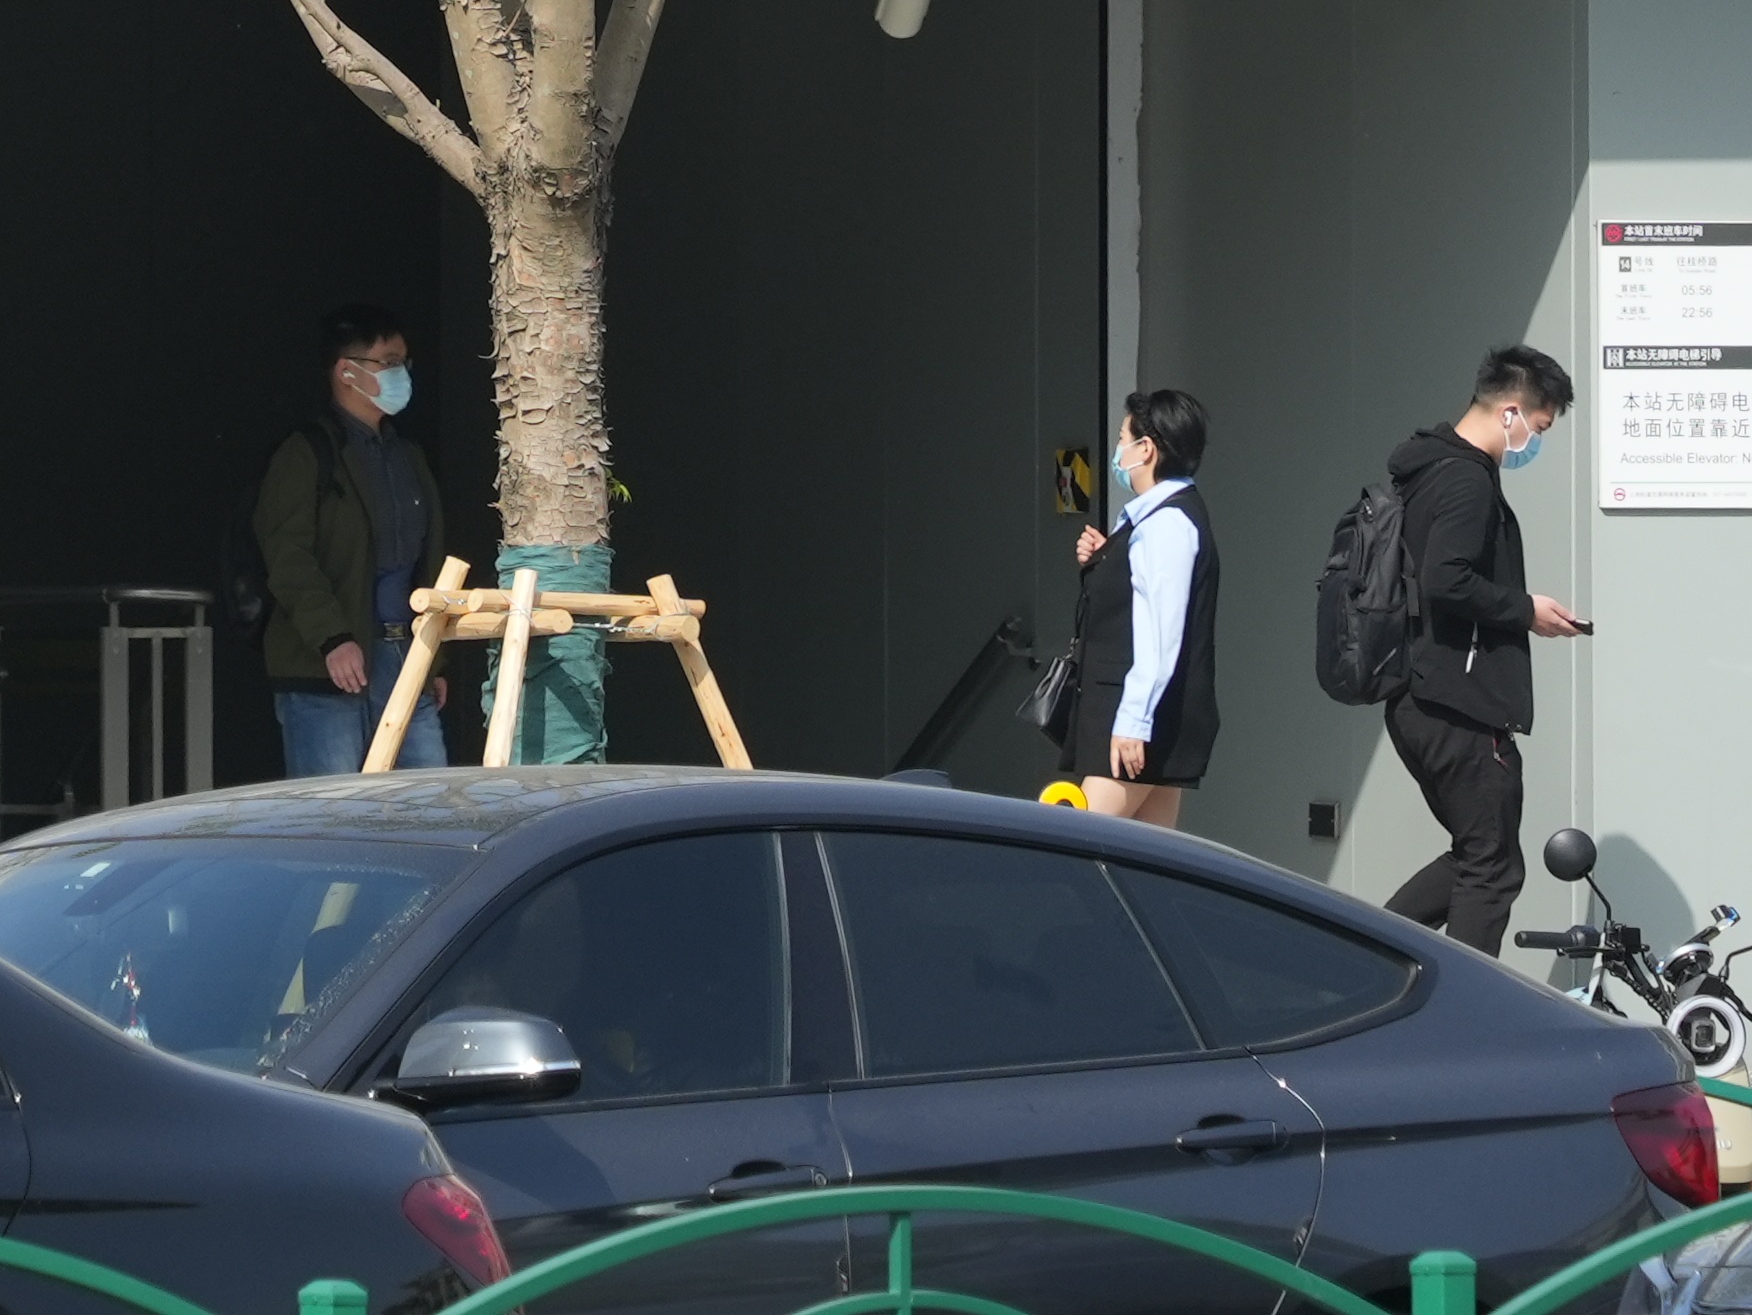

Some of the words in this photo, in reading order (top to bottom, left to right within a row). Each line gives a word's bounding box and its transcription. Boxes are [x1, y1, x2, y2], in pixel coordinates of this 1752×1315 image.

[1681, 284, 1713, 296] 05:56
[1681, 307, 1713, 318] 22:56
[1620, 452, 1683, 464] Accessible
[1687, 452, 1738, 464] Elevator:
